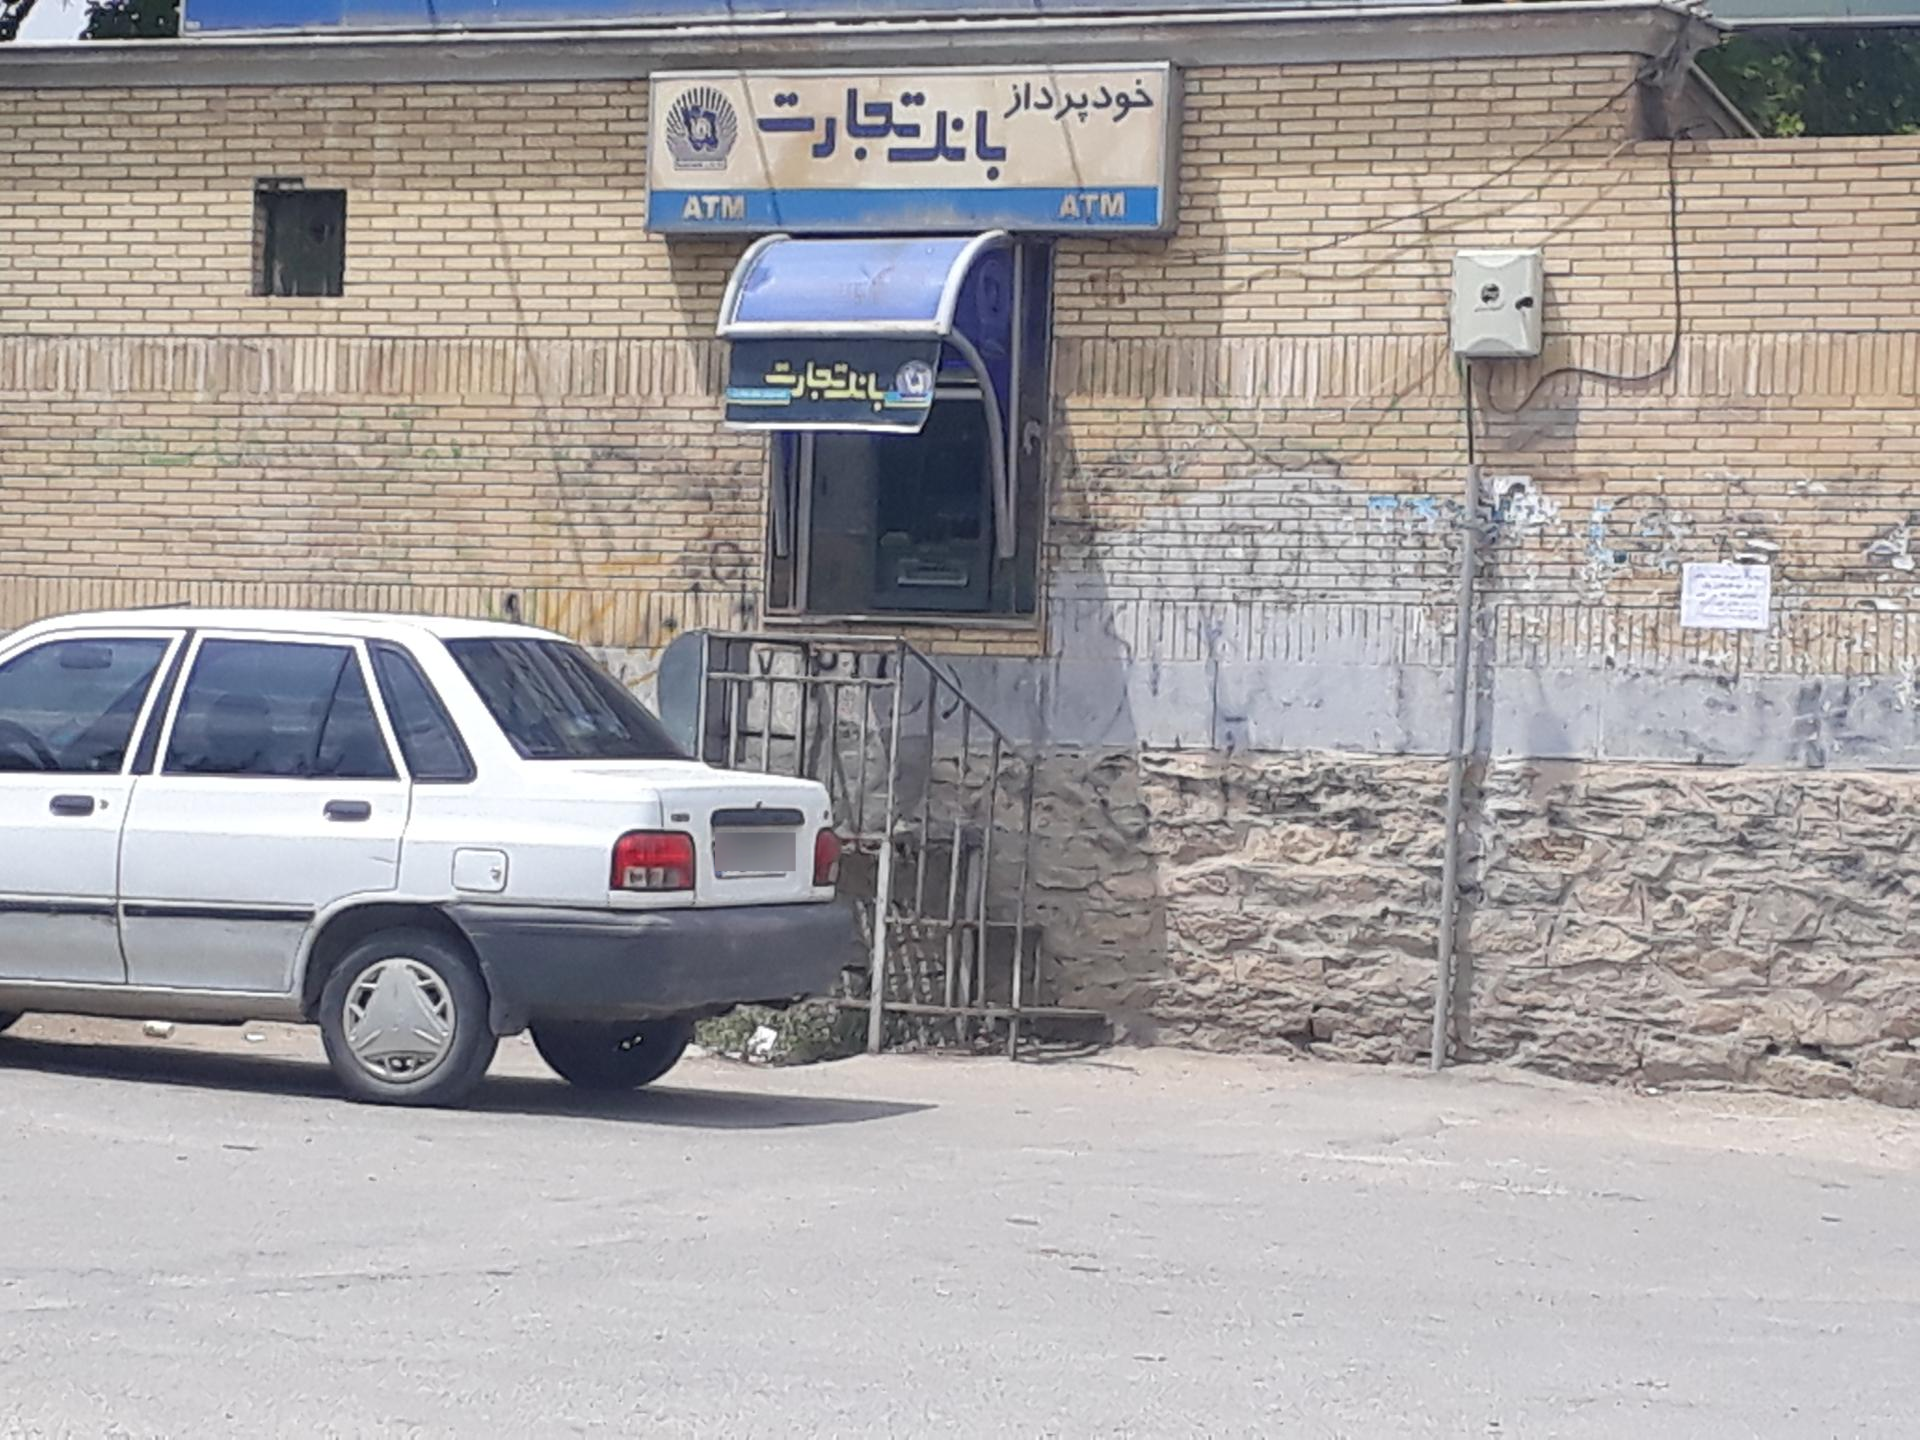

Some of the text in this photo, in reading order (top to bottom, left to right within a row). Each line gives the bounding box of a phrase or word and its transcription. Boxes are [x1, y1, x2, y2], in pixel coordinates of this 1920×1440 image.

[1003, 78, 1154, 123] خودپرداز
[757, 87, 1007, 181] بانک تجارت
[682, 194, 746, 221] ATM
[1059, 192, 1126, 219] ATM
[764, 361, 885, 412] بانک تجارت
